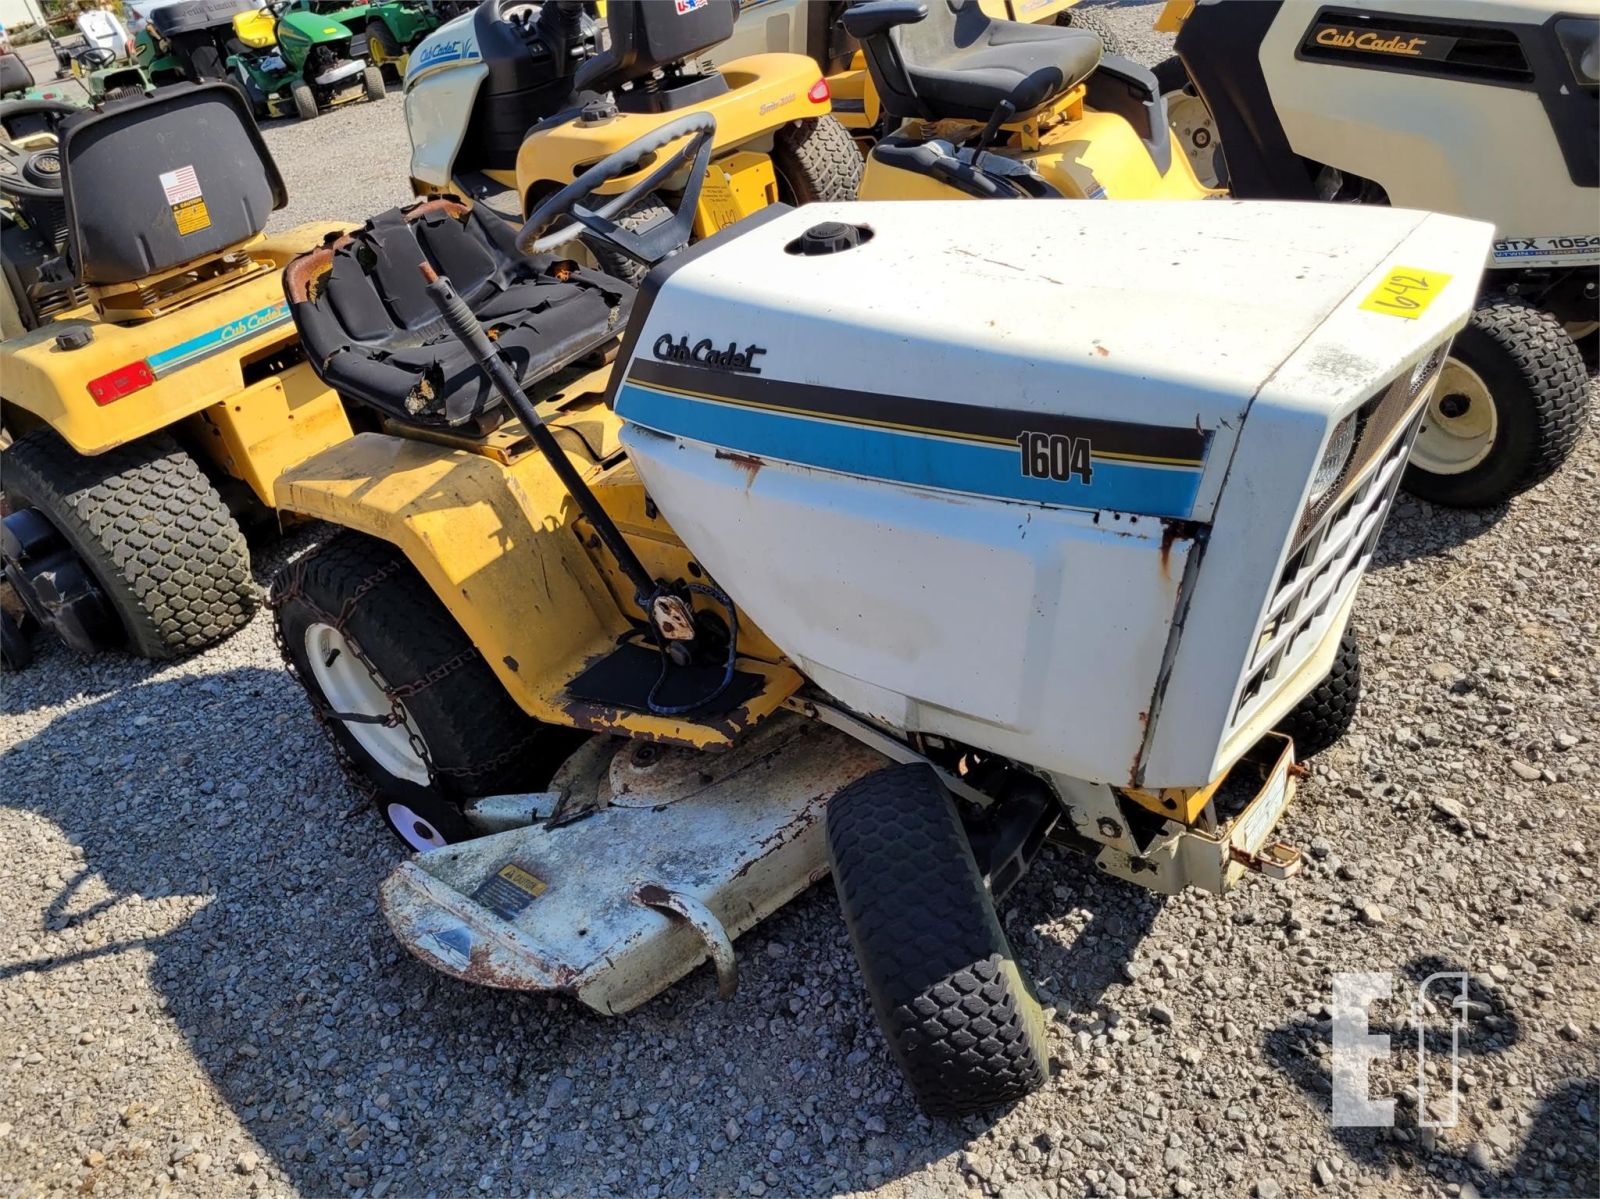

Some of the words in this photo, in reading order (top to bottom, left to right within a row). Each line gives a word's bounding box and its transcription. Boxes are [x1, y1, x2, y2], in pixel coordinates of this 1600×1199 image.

[1316, 28, 1355, 47] Cub
[1355, 32, 1427, 55] Cadet
[1493, 240, 1538, 251] GTX
[1547, 237, 1600, 249] 1054
[1374, 275, 1430, 310] 642
[220, 322, 247, 342] Cub
[653, 333, 691, 362] Cub
[691, 338, 767, 374] Cadet
[1016, 430, 1094, 486] 1604
